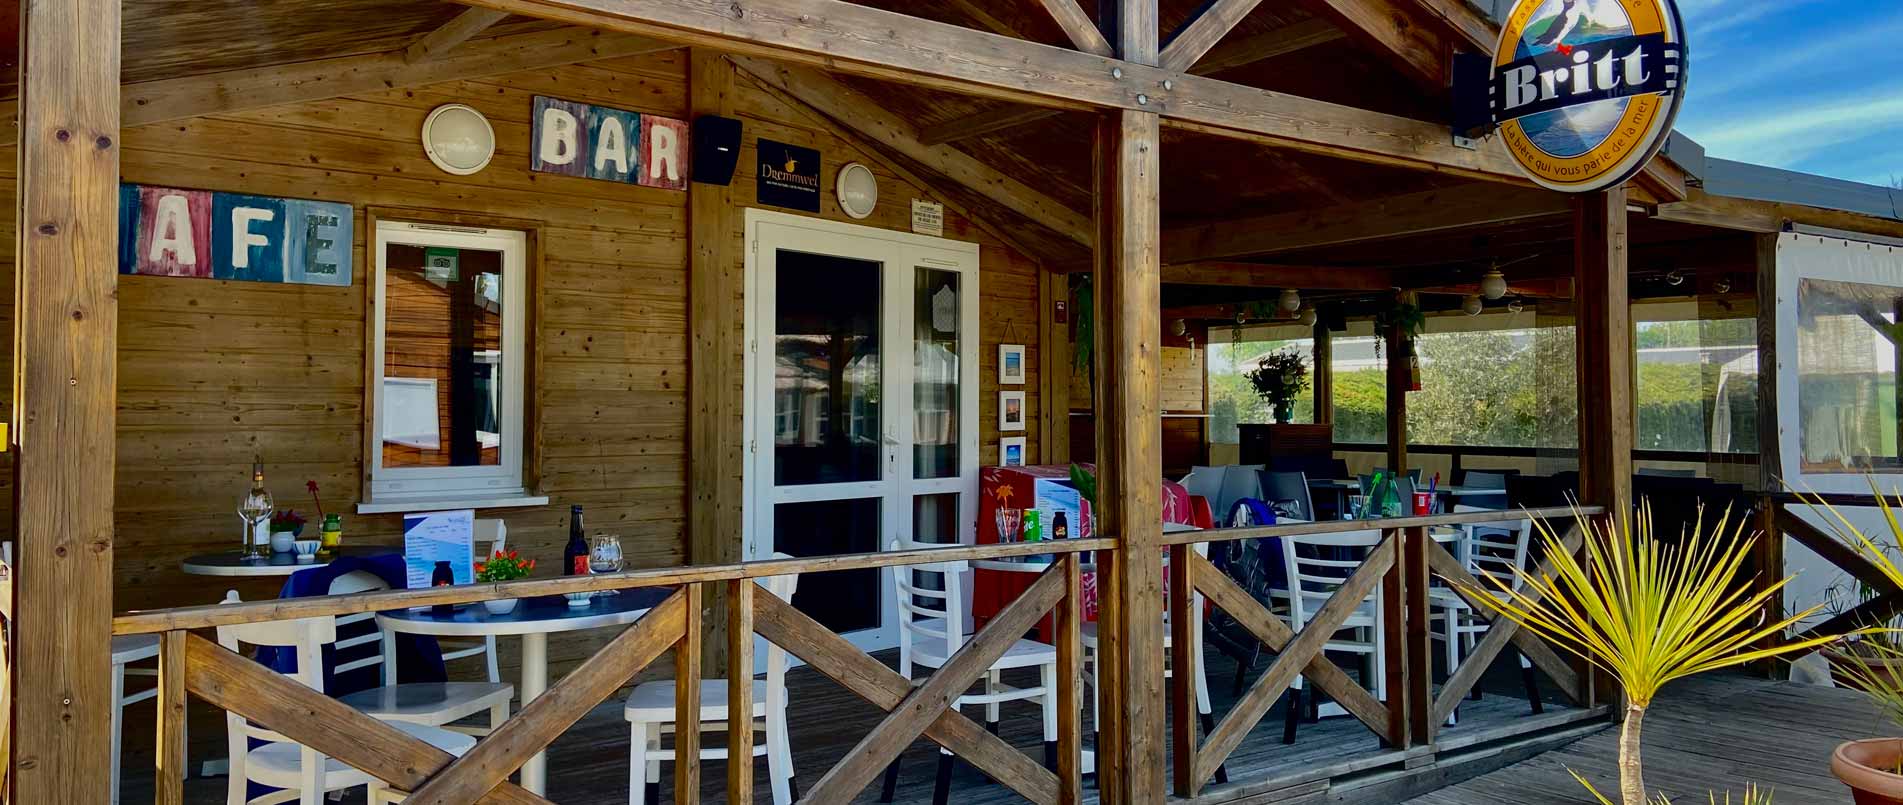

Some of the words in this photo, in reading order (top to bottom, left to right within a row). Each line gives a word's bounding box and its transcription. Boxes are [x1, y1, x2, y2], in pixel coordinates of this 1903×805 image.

[1503, 45, 1650, 111] Britt
[540, 108, 679, 181] BAR
[1507, 124, 1515, 140] La
[1514, 138, 1534, 162] bière
[1535, 160, 1551, 173] qui
[1554, 167, 1580, 176] vous
[1583, 151, 1611, 175] parle
[1612, 139, 1625, 153] de
[1623, 127, 1636, 138] la
[1633, 101, 1649, 124] mer
[151, 194, 338, 274] AFE
